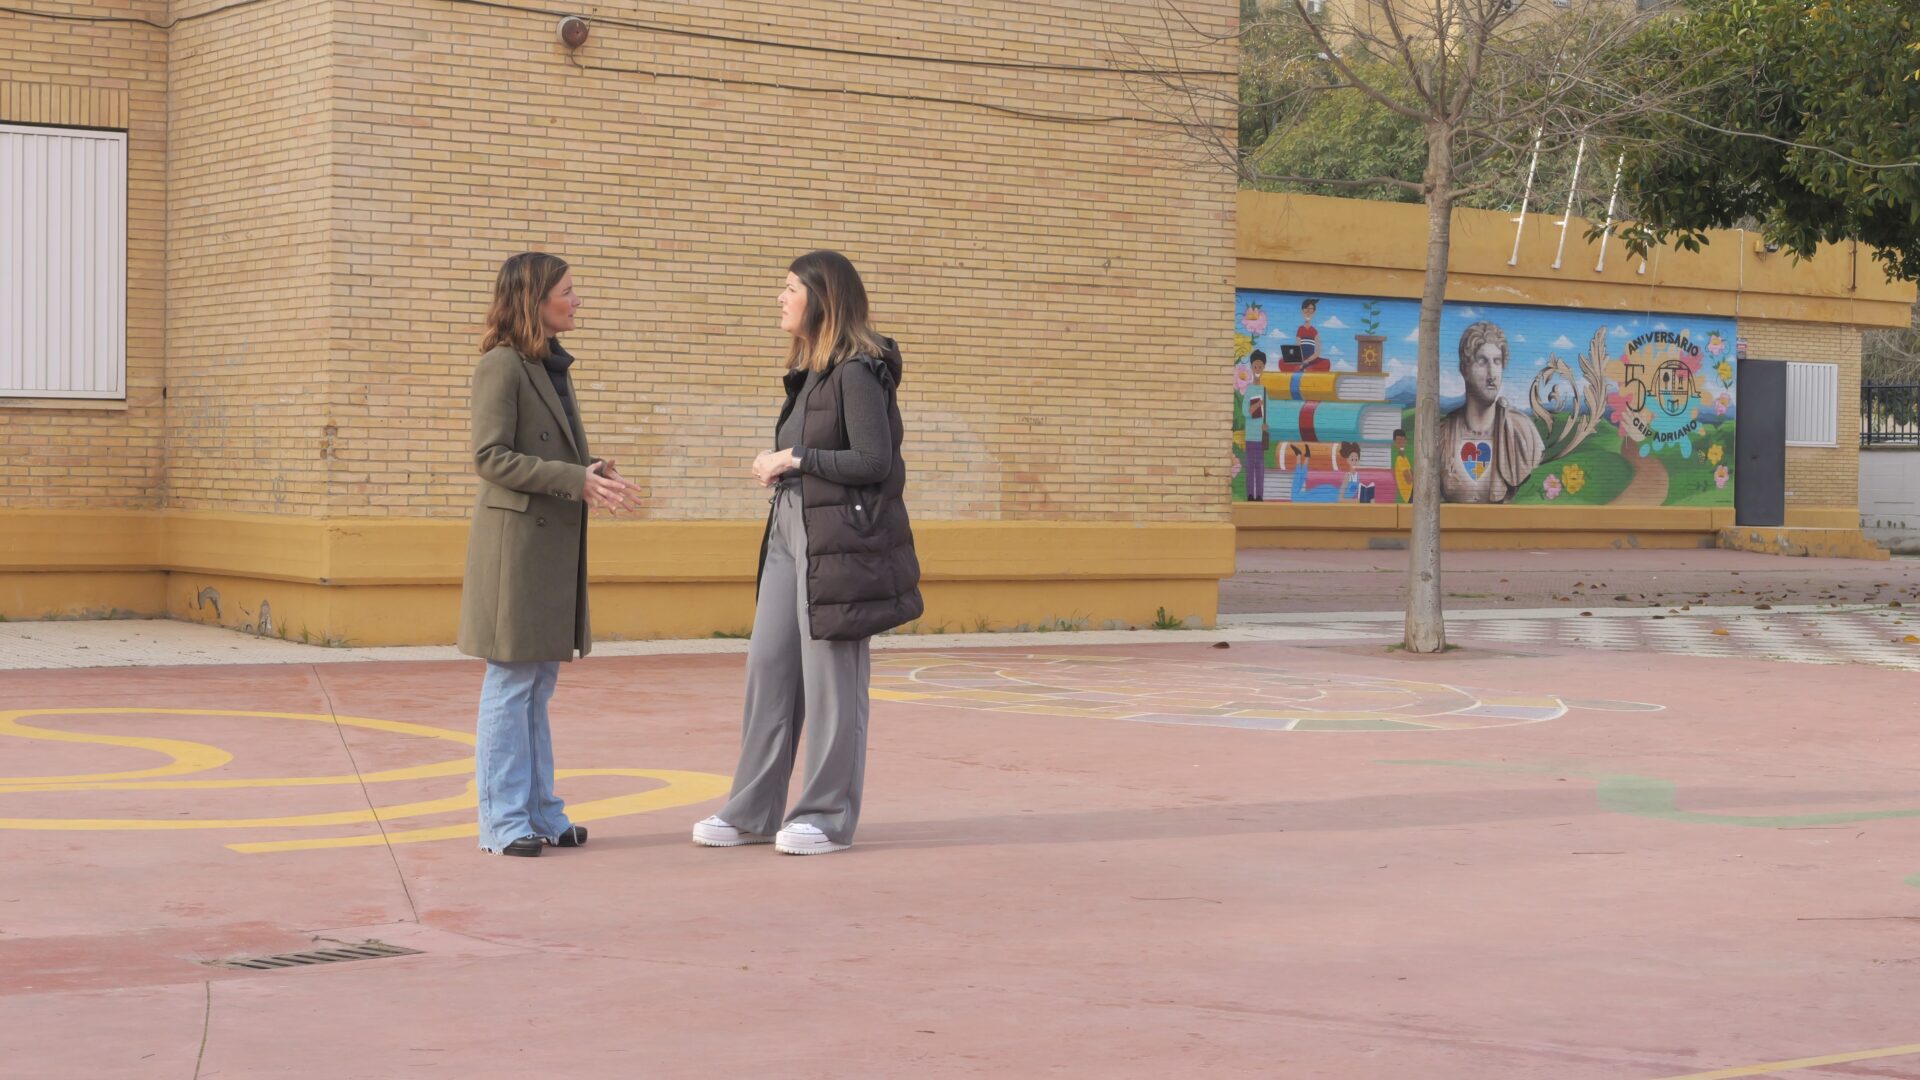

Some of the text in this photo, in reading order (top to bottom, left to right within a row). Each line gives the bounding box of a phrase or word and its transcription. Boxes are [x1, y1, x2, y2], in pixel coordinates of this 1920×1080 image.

[1628, 331, 1699, 356] ANIVERSARIO
[1632, 417, 1697, 442] CEIP ADRIANO
